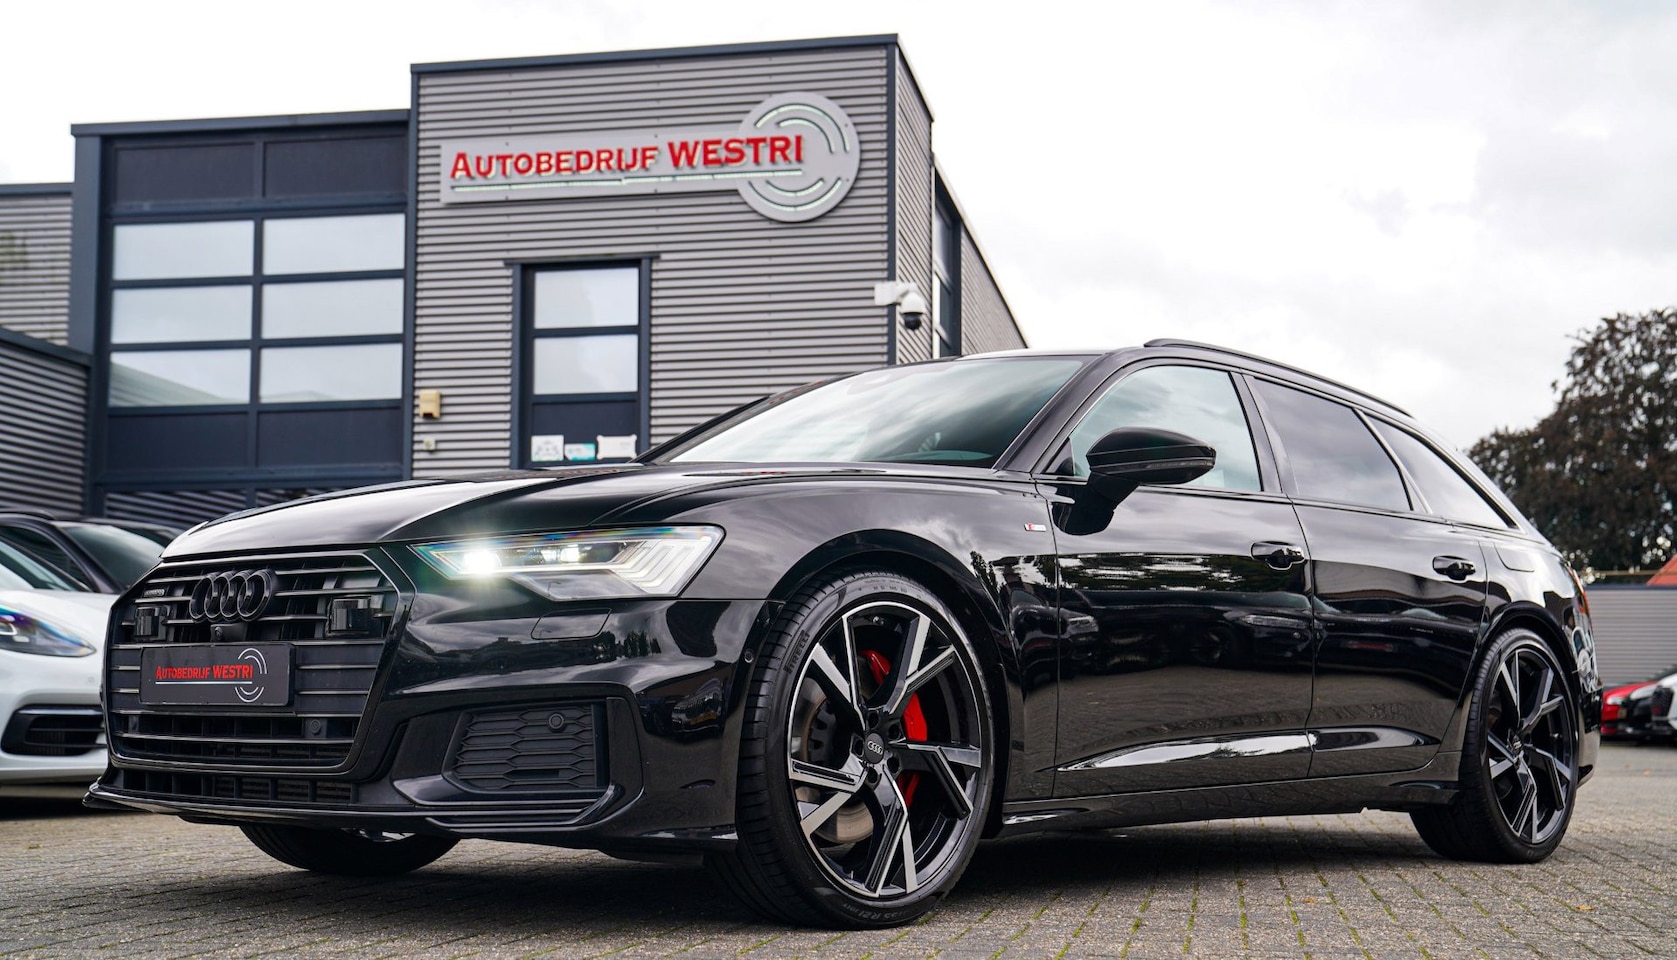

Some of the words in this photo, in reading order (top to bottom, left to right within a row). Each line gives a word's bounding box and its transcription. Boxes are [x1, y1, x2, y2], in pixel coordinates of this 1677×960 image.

[450, 146, 659, 179] AUTOBEDRIJF
[667, 135, 803, 168] WESTRI
[155, 666, 211, 679] AUTOBEDRIJF
[212, 664, 254, 679] WESTRI
[783, 630, 810, 674] PIRELLI
